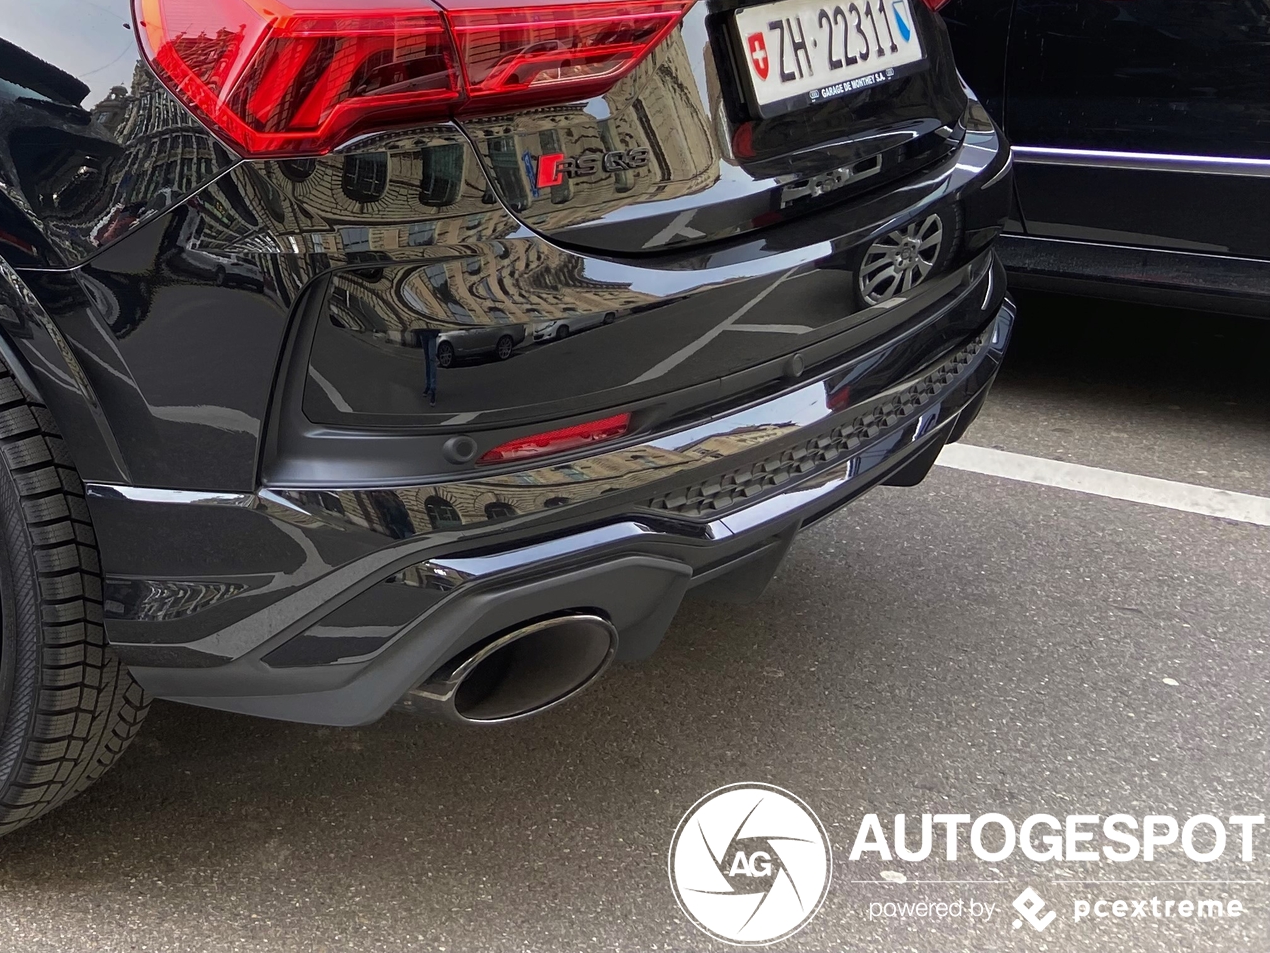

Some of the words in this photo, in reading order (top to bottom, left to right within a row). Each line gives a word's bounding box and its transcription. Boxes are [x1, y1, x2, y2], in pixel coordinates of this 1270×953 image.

[821, 84, 845, 98] GARAGE
[843, 81, 852, 92] DE
[552, 154, 599, 181] RS
